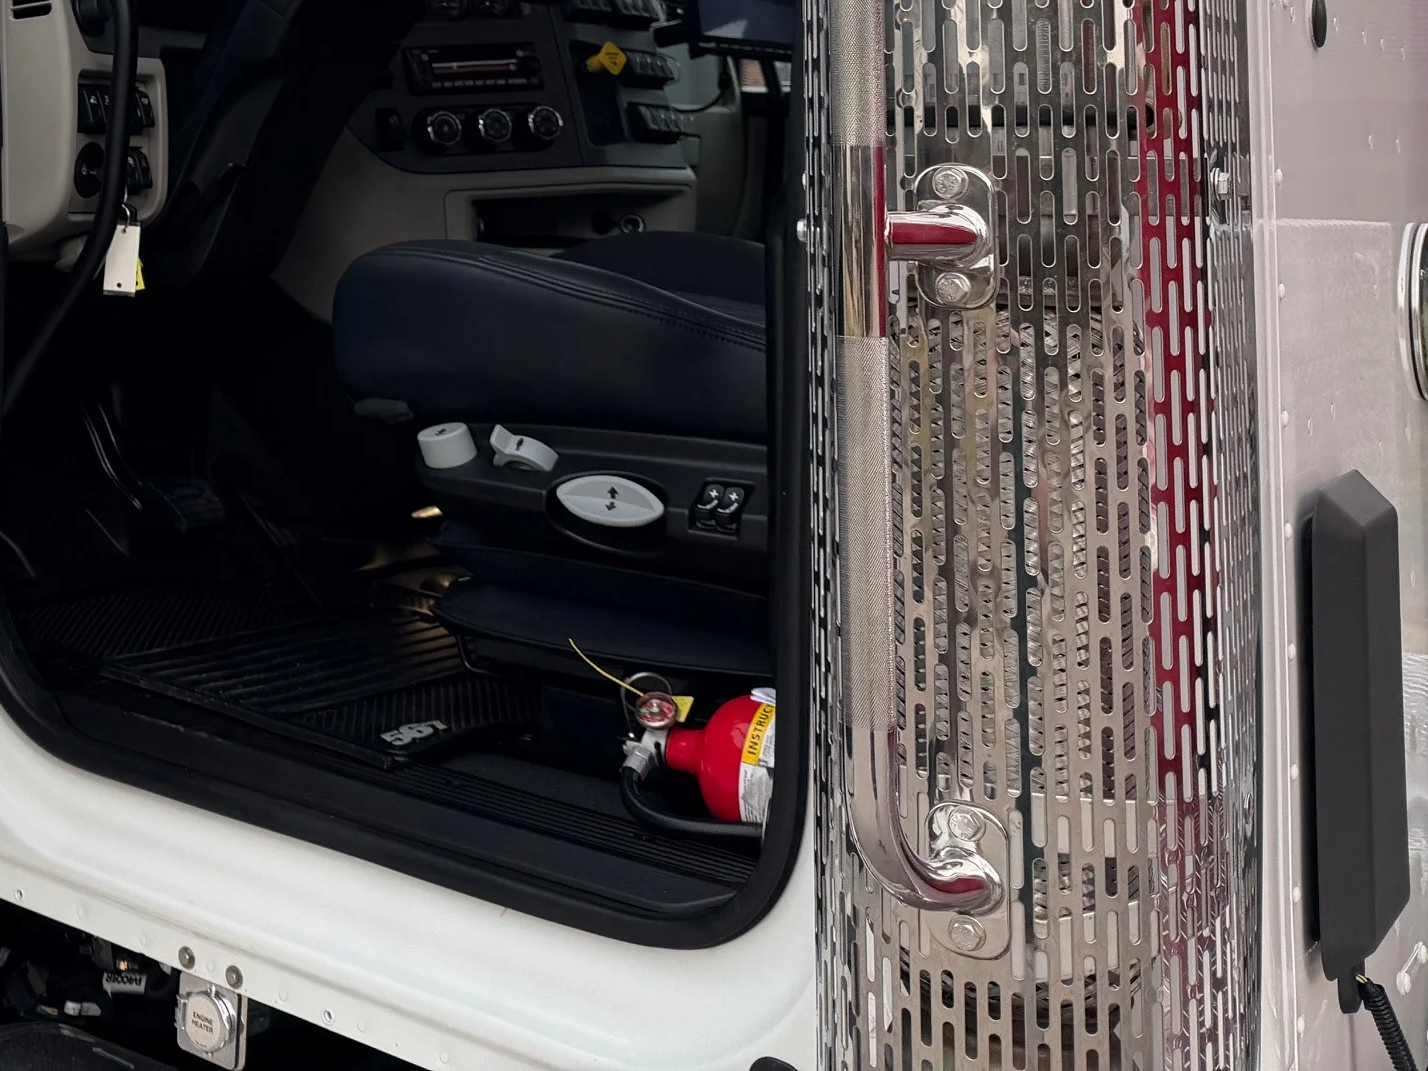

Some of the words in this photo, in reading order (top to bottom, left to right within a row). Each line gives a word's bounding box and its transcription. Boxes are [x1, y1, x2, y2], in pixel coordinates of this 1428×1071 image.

[380, 720, 449, 747] 567
[747, 703, 774, 756] INSTRUC
[191, 1018, 214, 1035] HEATER
[192, 1010, 213, 1025] ENGINE
